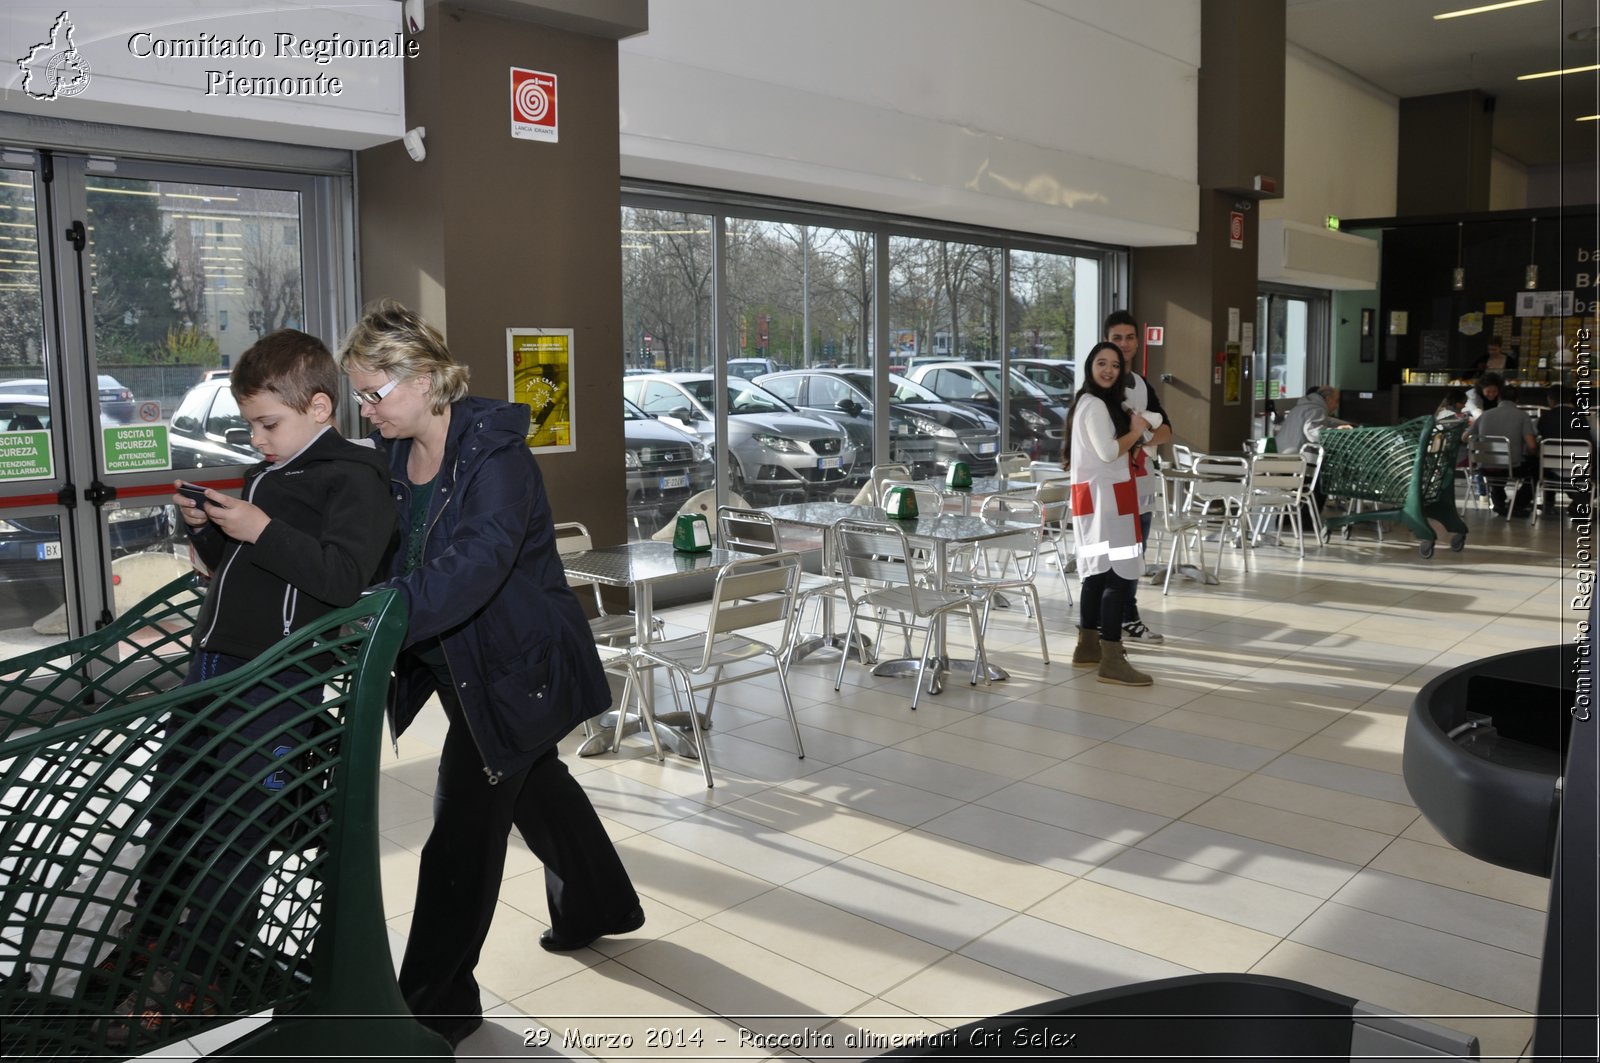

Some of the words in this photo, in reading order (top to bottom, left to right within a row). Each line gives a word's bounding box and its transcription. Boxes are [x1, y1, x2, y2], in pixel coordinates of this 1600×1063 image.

[534, 127, 554, 135] IDRANTE
[117, 430, 145, 439] USCITA
[146, 429, 154, 437] DI
[25, 436, 33, 444] DI
[115, 440, 157, 450] SICUREZZA
[118, 451, 156, 460] ATTENZIONE
[108, 460, 130, 469] PORTA
[130, 458, 167, 467] ALLARMATA
[7, 467, 48, 475] ALLARMATA
[46, 545, 57, 556] BX
